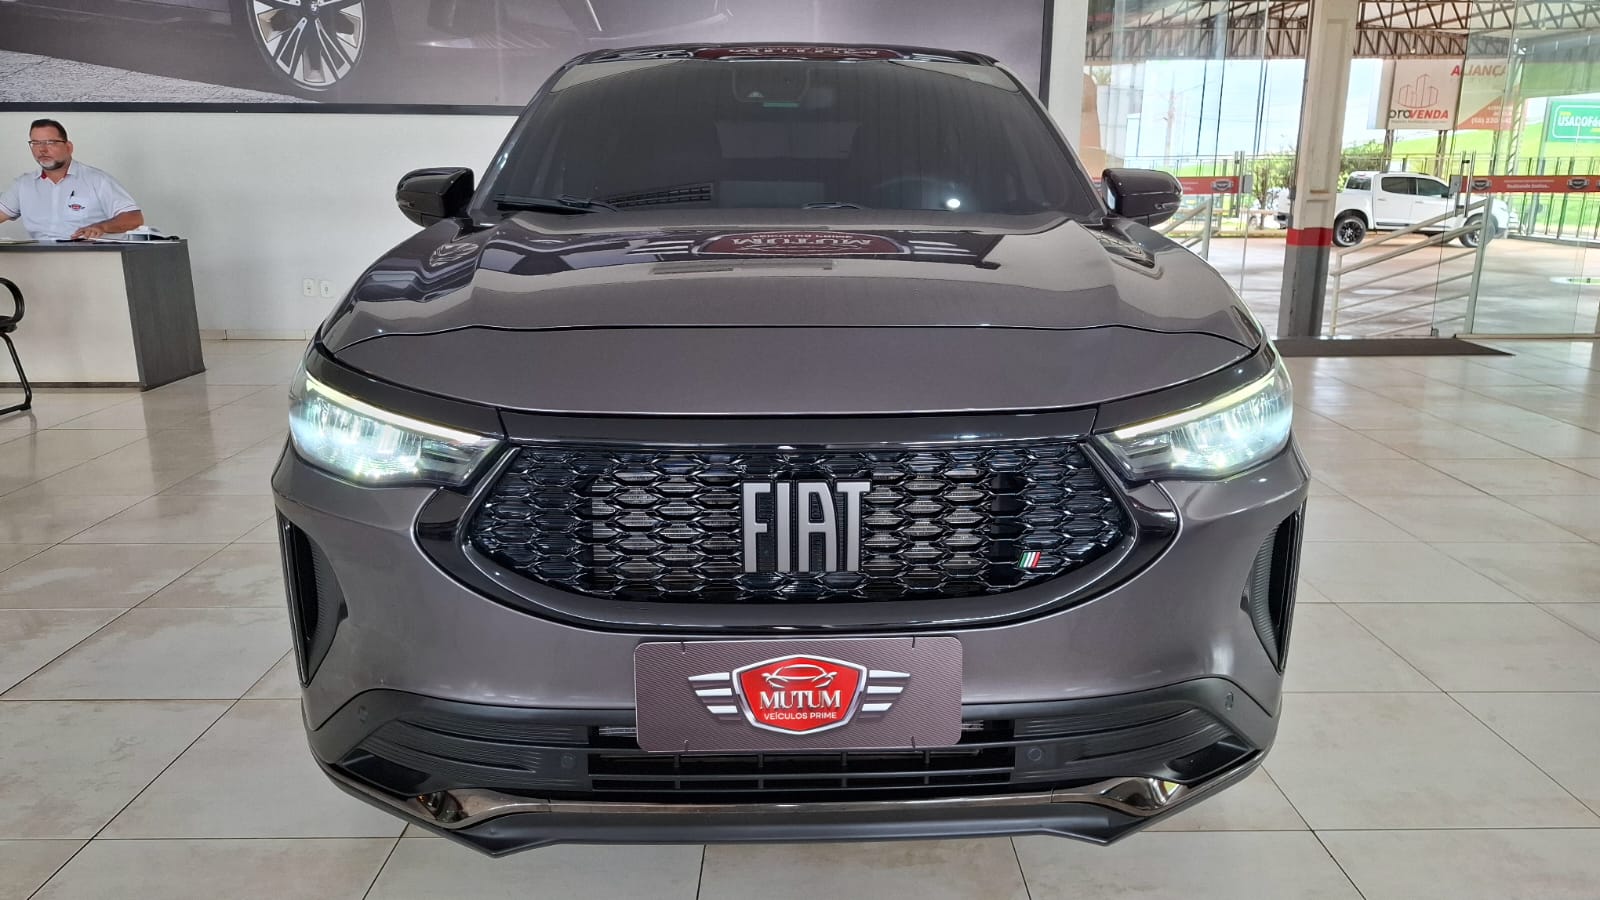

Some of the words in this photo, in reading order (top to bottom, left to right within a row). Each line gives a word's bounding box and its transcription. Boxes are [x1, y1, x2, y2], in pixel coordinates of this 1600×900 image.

[743, 482, 871, 572] FIAT
[759, 690, 841, 709] MUTUM
[764, 712, 808, 720] VEÍCULOS
